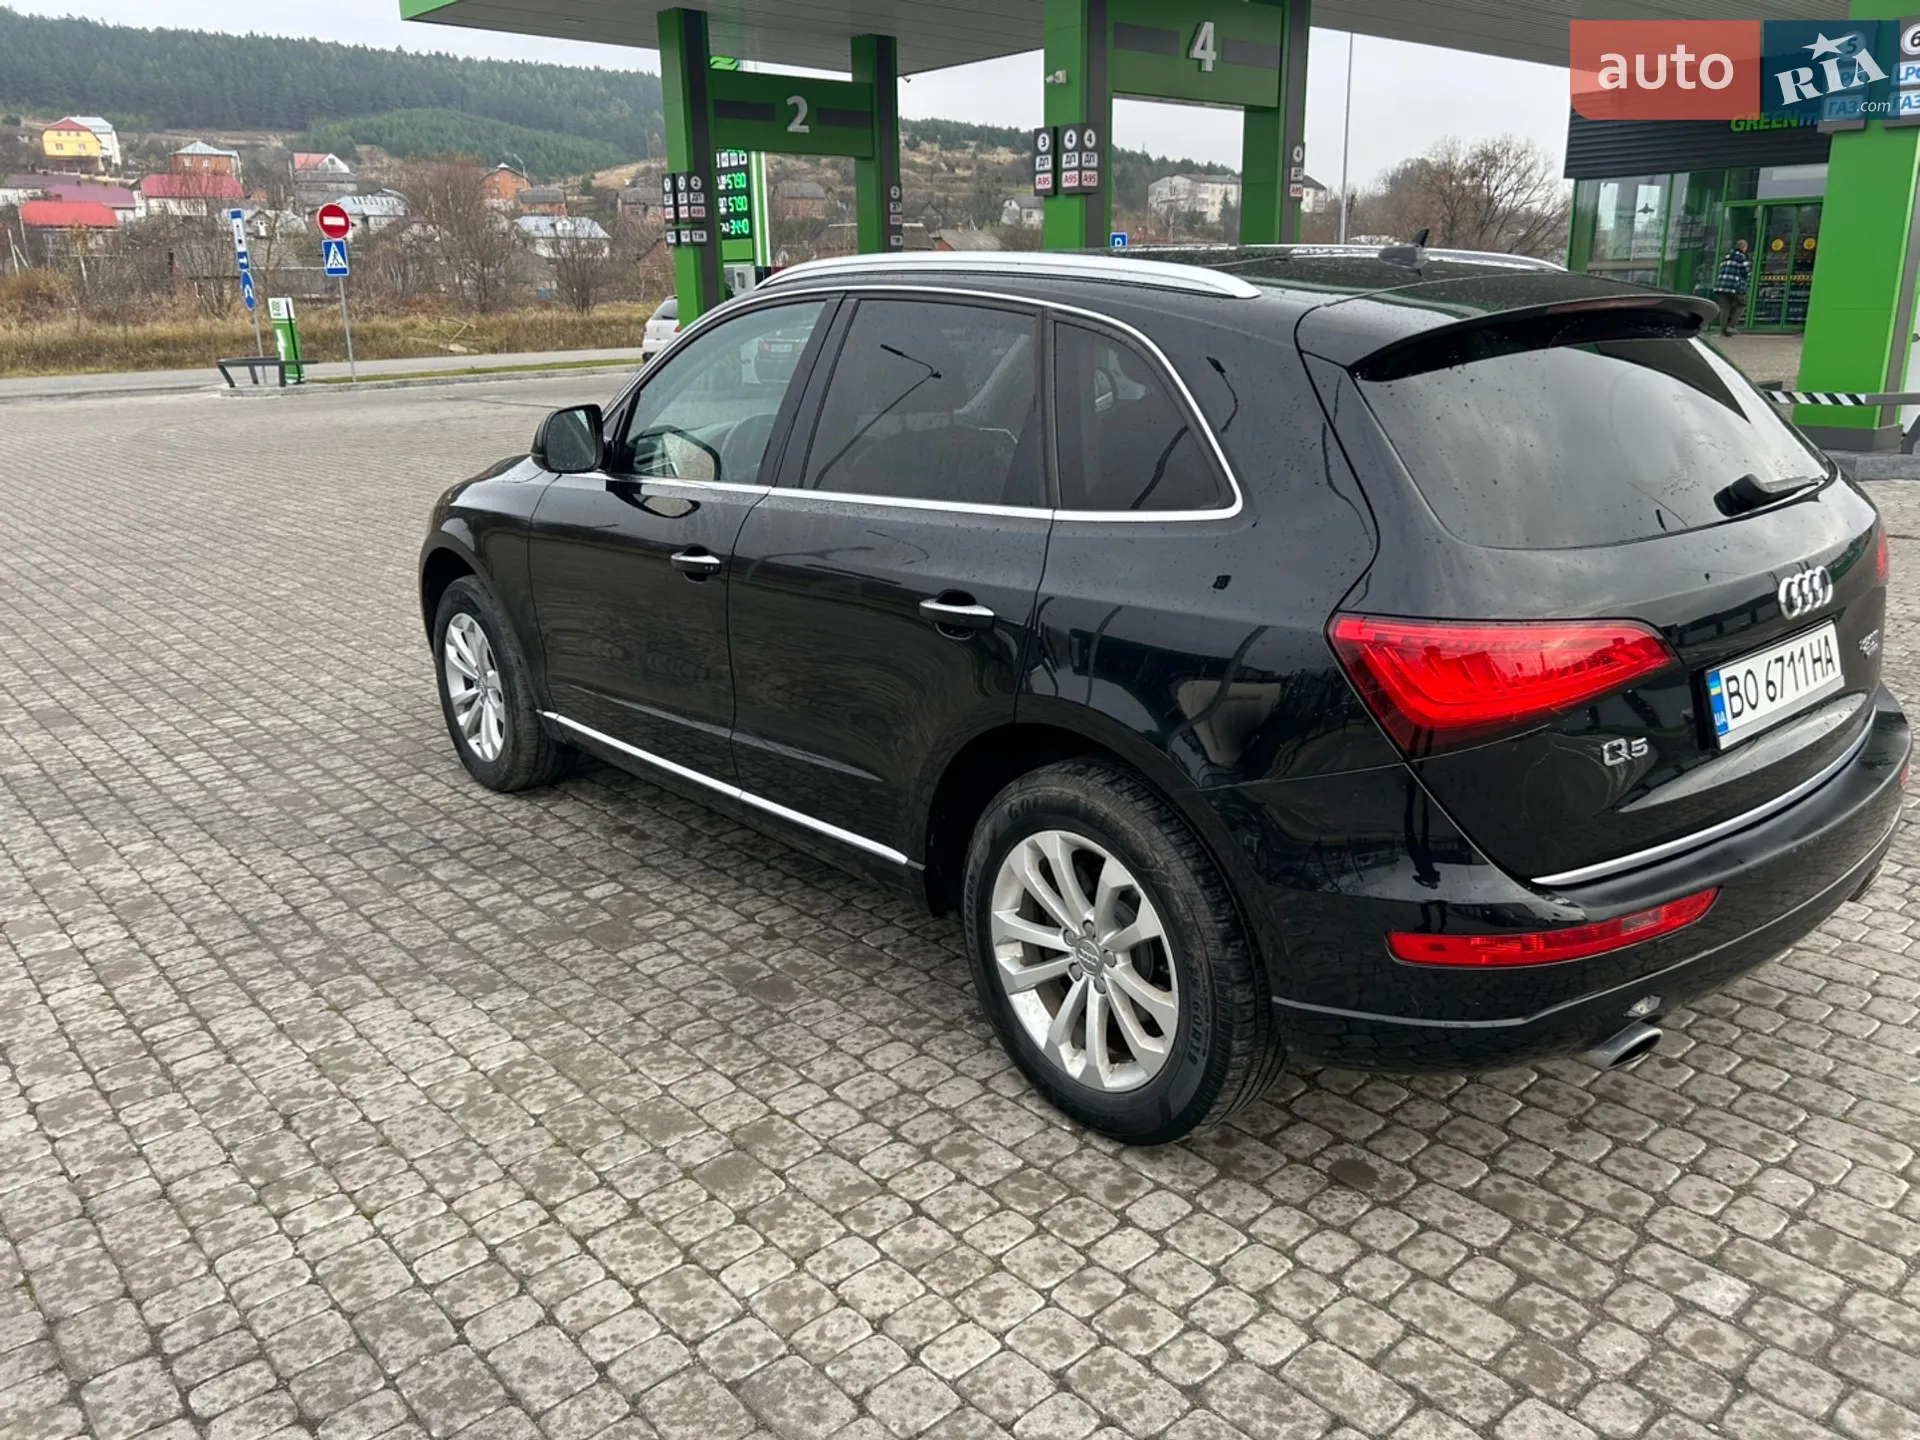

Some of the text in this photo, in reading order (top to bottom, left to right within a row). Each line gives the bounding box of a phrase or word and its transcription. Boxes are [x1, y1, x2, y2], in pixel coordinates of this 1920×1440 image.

[1190, 21, 1217, 72] 4
[786, 95, 810, 133] 2
[1040, 135, 1048, 148] 3
[1725, 669, 1759, 719] BO
[1765, 646, 1810, 702] 6711
[1809, 635, 1836, 682] HA
[1714, 711, 1727, 727] UA
[1603, 738, 1648, 767] Q5
